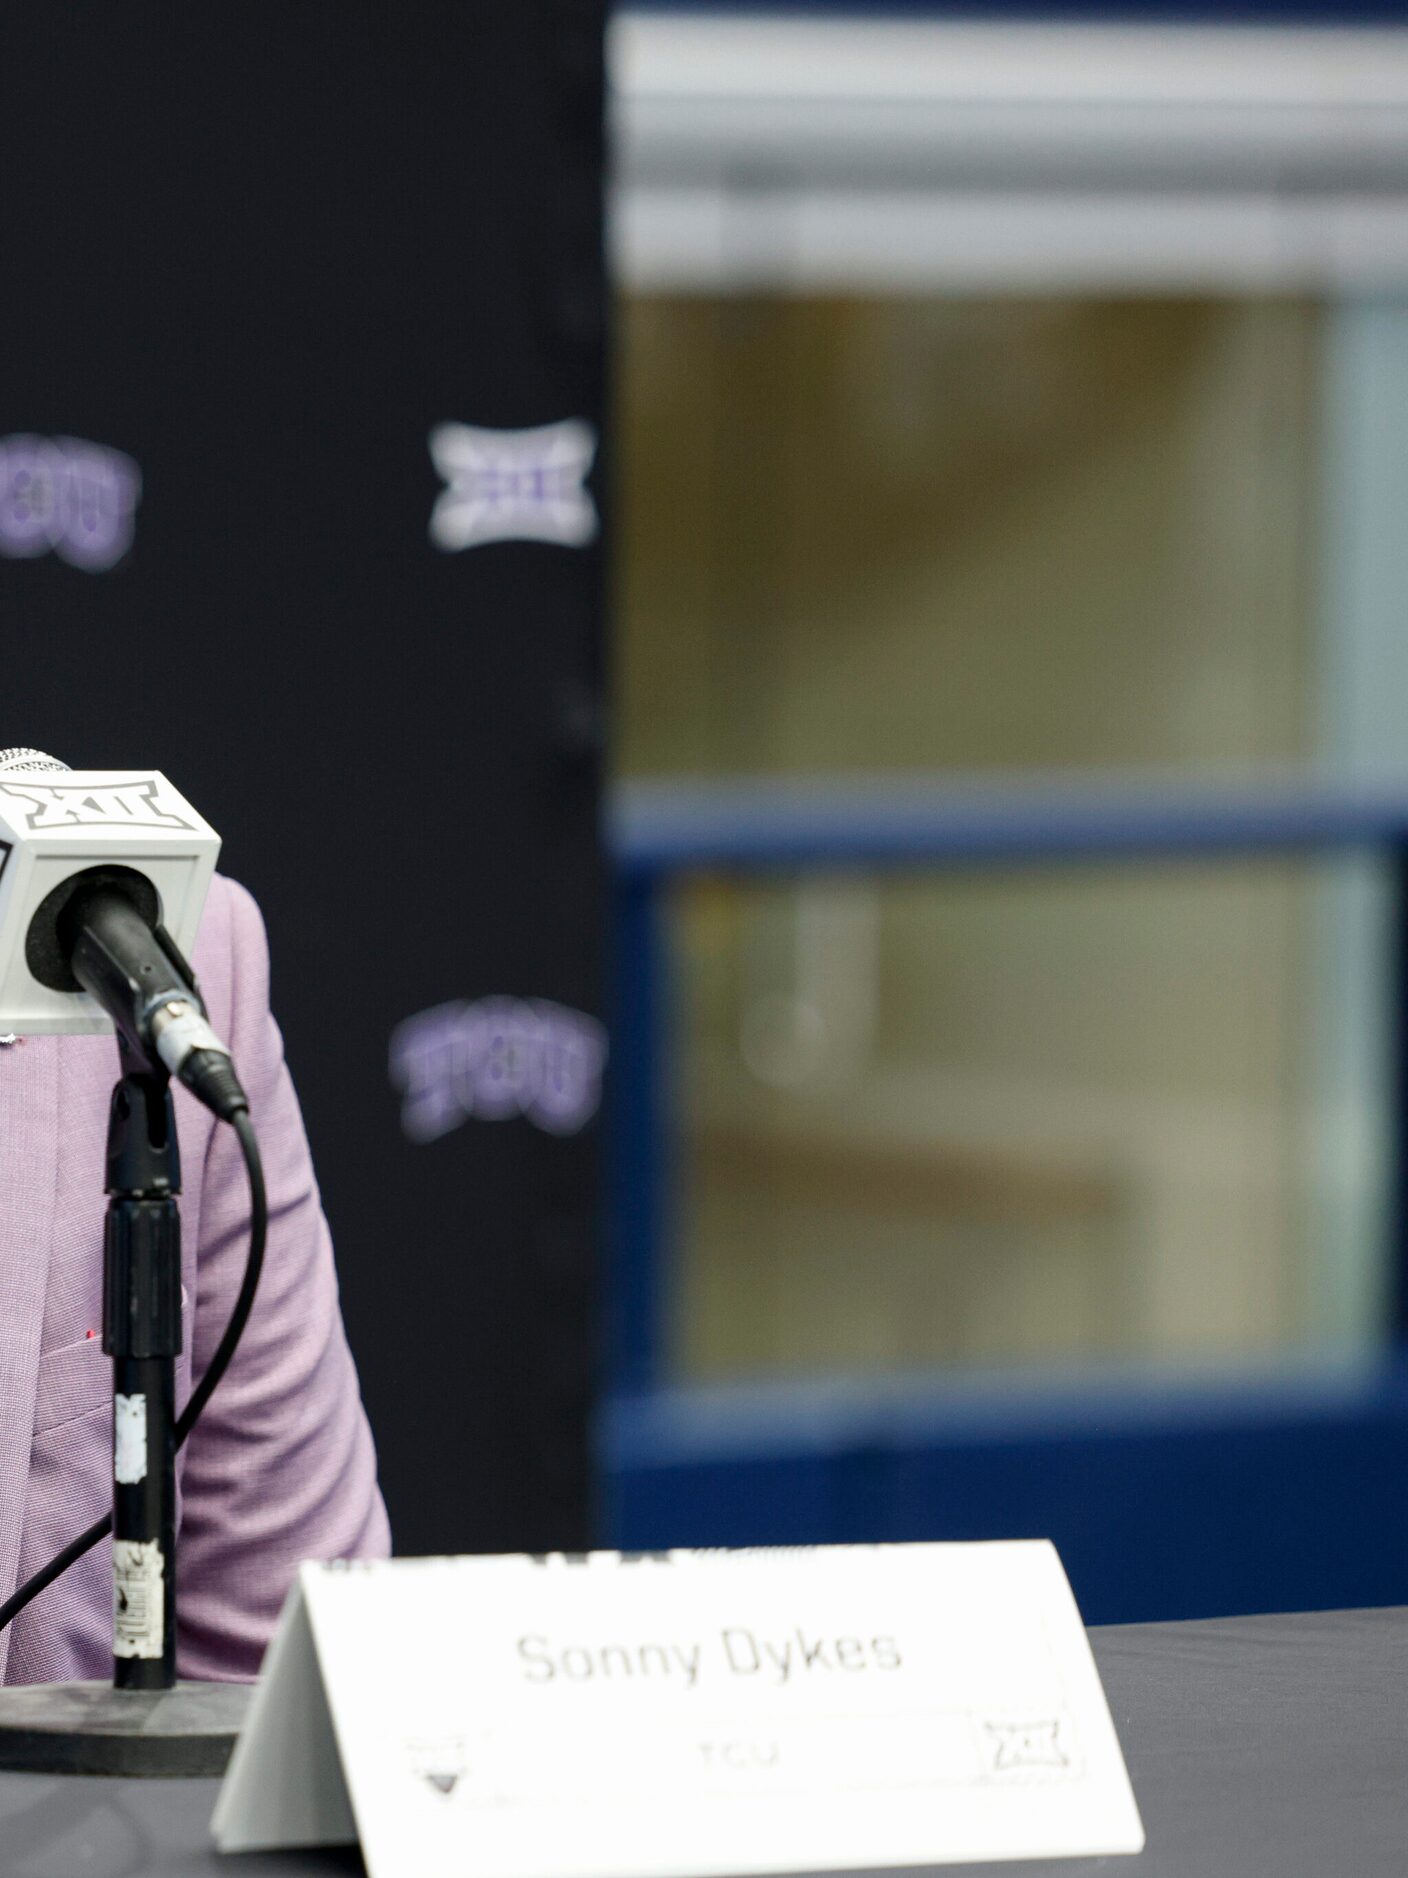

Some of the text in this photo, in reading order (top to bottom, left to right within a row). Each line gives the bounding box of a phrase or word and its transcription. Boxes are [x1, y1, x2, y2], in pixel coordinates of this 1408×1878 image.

[389, 996, 609, 1145] TCU
[517, 1626, 903, 1689] Sonny Dykes
[697, 1739, 781, 1771] TCU
